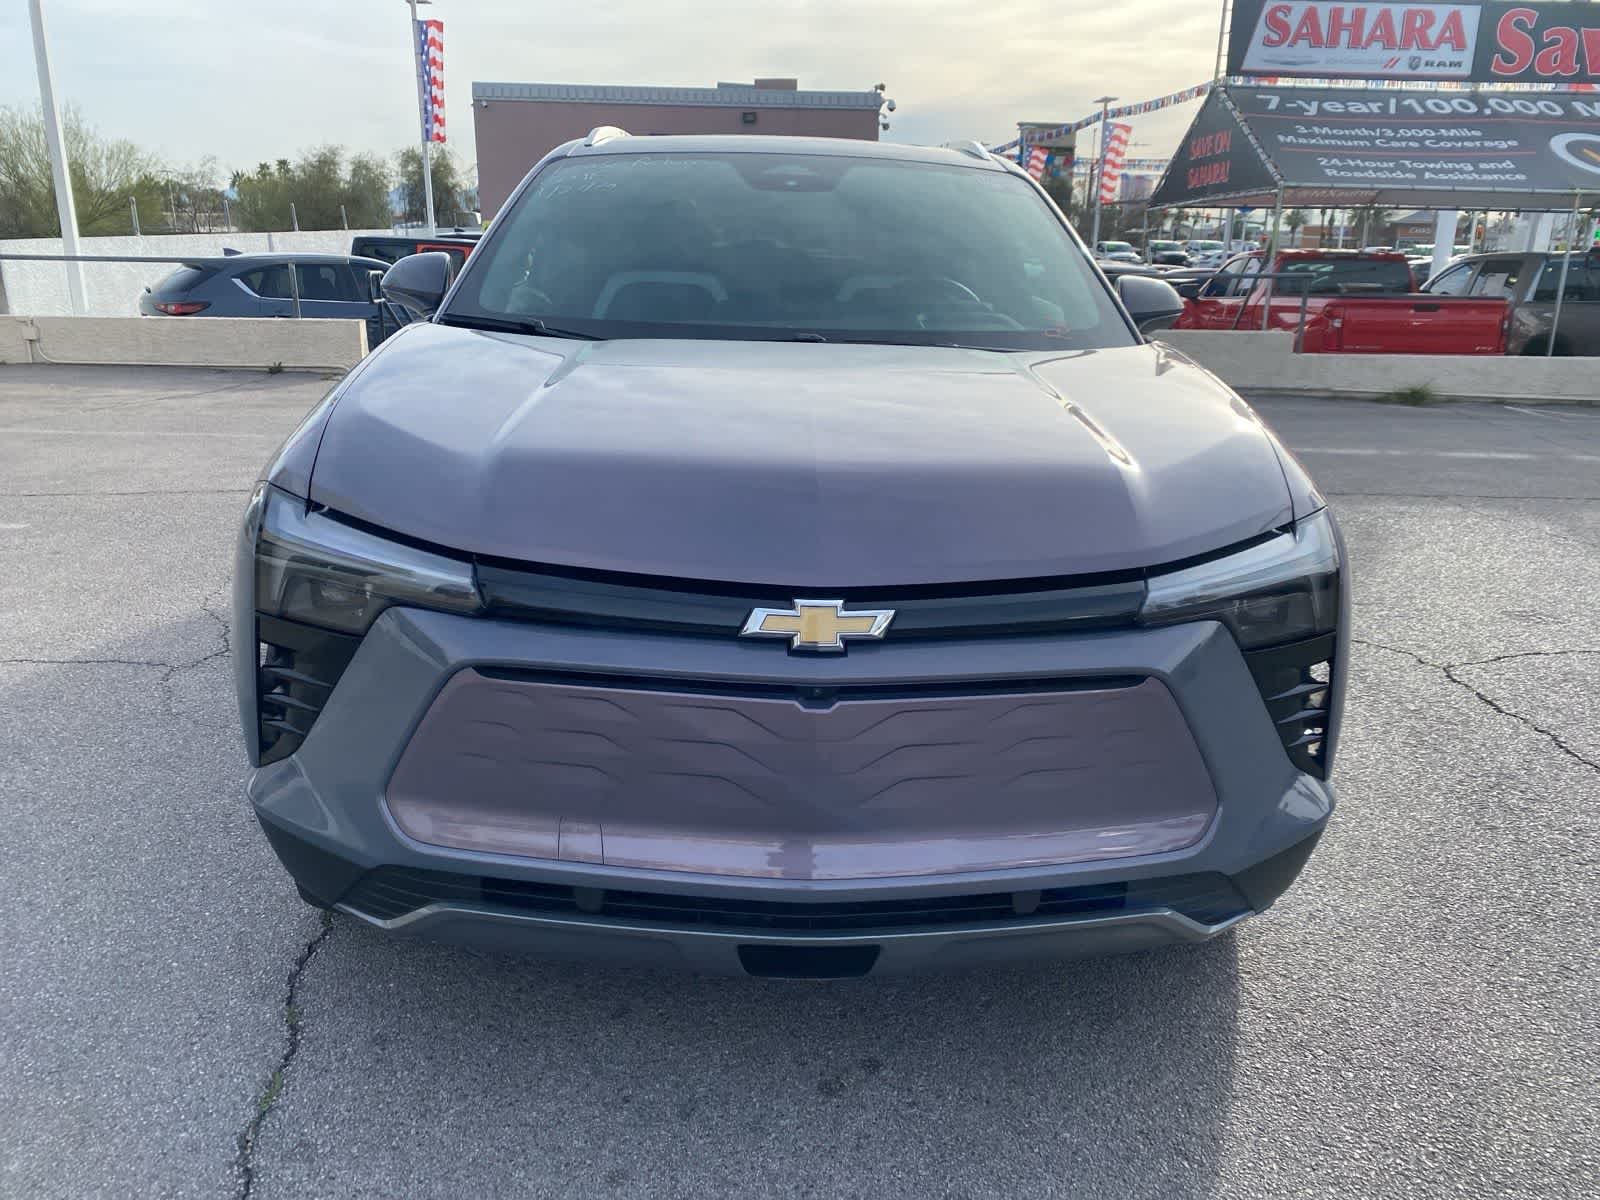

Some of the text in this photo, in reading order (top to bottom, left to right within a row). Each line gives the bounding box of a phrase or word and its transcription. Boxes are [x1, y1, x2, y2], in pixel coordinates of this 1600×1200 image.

[1263, 5, 1467, 51] SAHARA
[1424, 60, 1463, 68] RAM
[1277, 135, 1520, 149] Maximum Care Coverage
[1316, 157, 1516, 171] 24-Hour Towing and
[1324, 168, 1528, 181] Roadside Assistance
